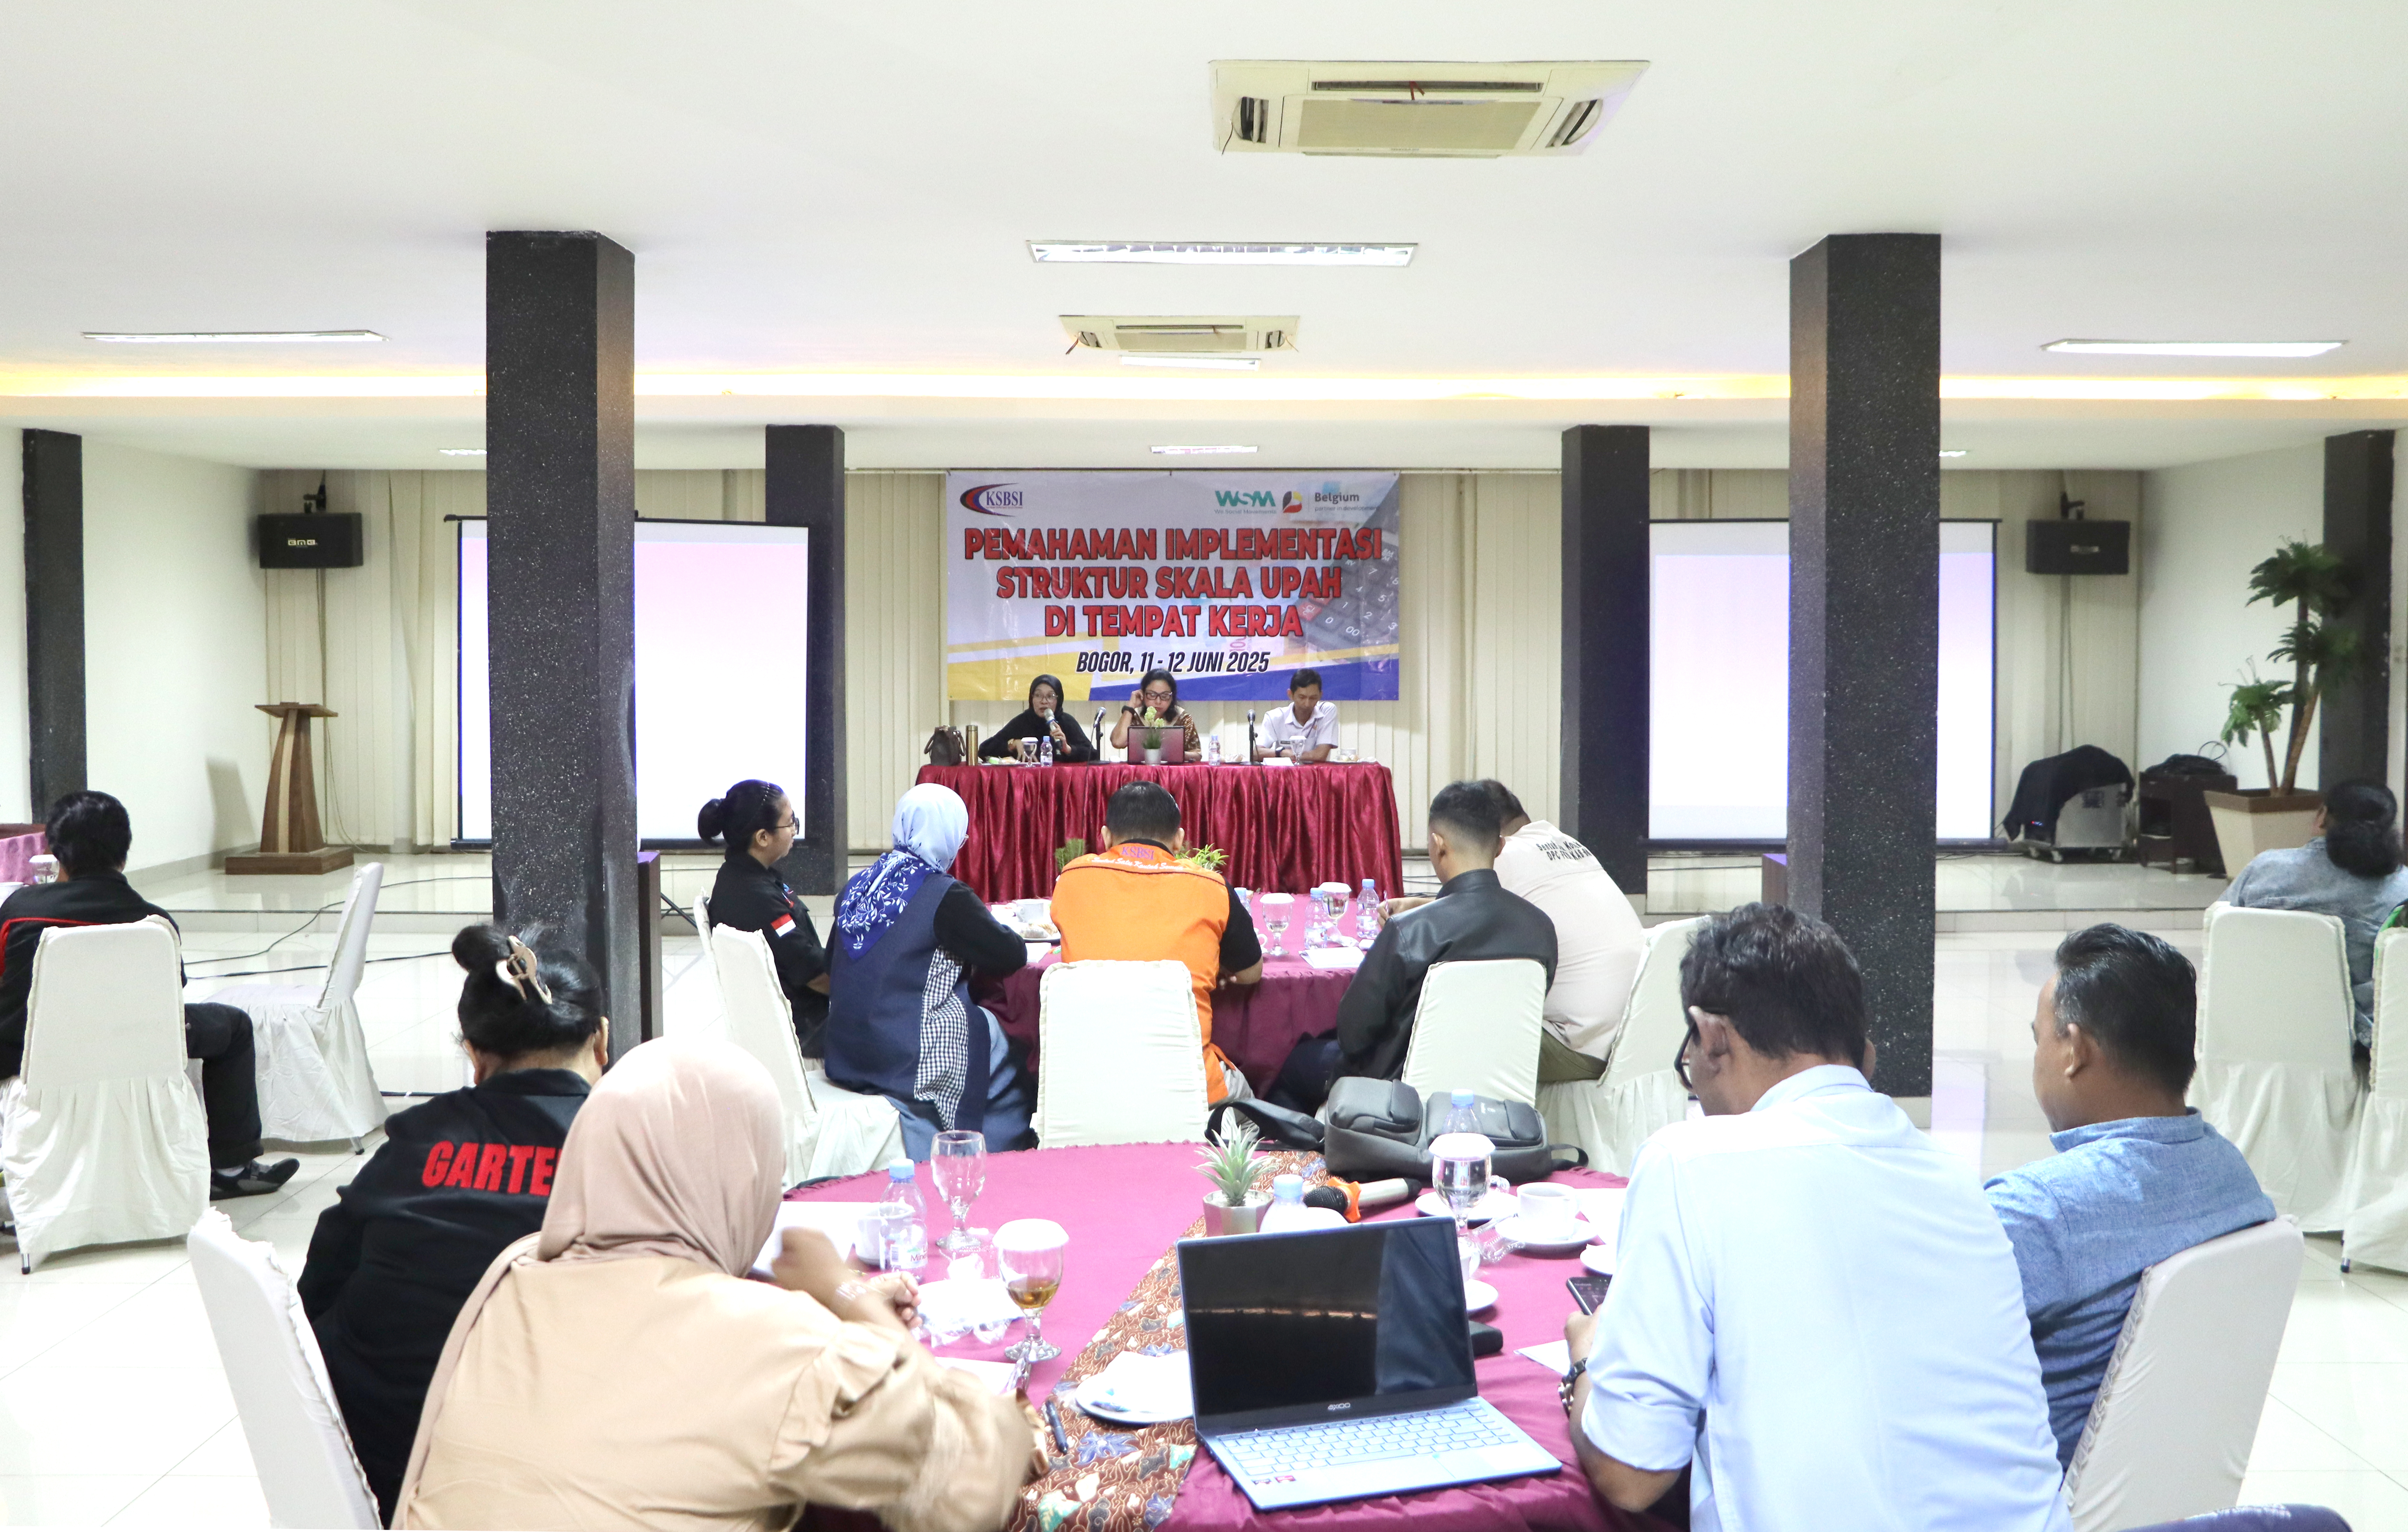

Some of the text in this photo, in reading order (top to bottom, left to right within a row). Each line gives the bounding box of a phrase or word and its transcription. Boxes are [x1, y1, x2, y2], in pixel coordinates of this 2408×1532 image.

[986, 491, 1023, 506] KSBSI
[1215, 490, 1276, 506] WSM
[1315, 492, 1359, 504] Belgium
[965, 528, 1156, 559] PEMAHAMAN
[1166, 528, 1382, 559] IMPLEMENTASI
[997, 566, 1341, 598] STRUKTUR SKALA UPAH
[1045, 605, 1303, 636] DI TEMPAT KERJA
[1346, 626, 1360, 636] 00
[1076, 651, 1134, 674] BOGOR,
[1140, 651, 1155, 672] 11
[1168, 651, 1185, 672] 12
[1187, 651, 1225, 672] JUNI
[1226, 651, 1271, 672] 2025
[1121, 846, 1155, 860] KSBSI
[422, 1140, 563, 1197] GARTE
